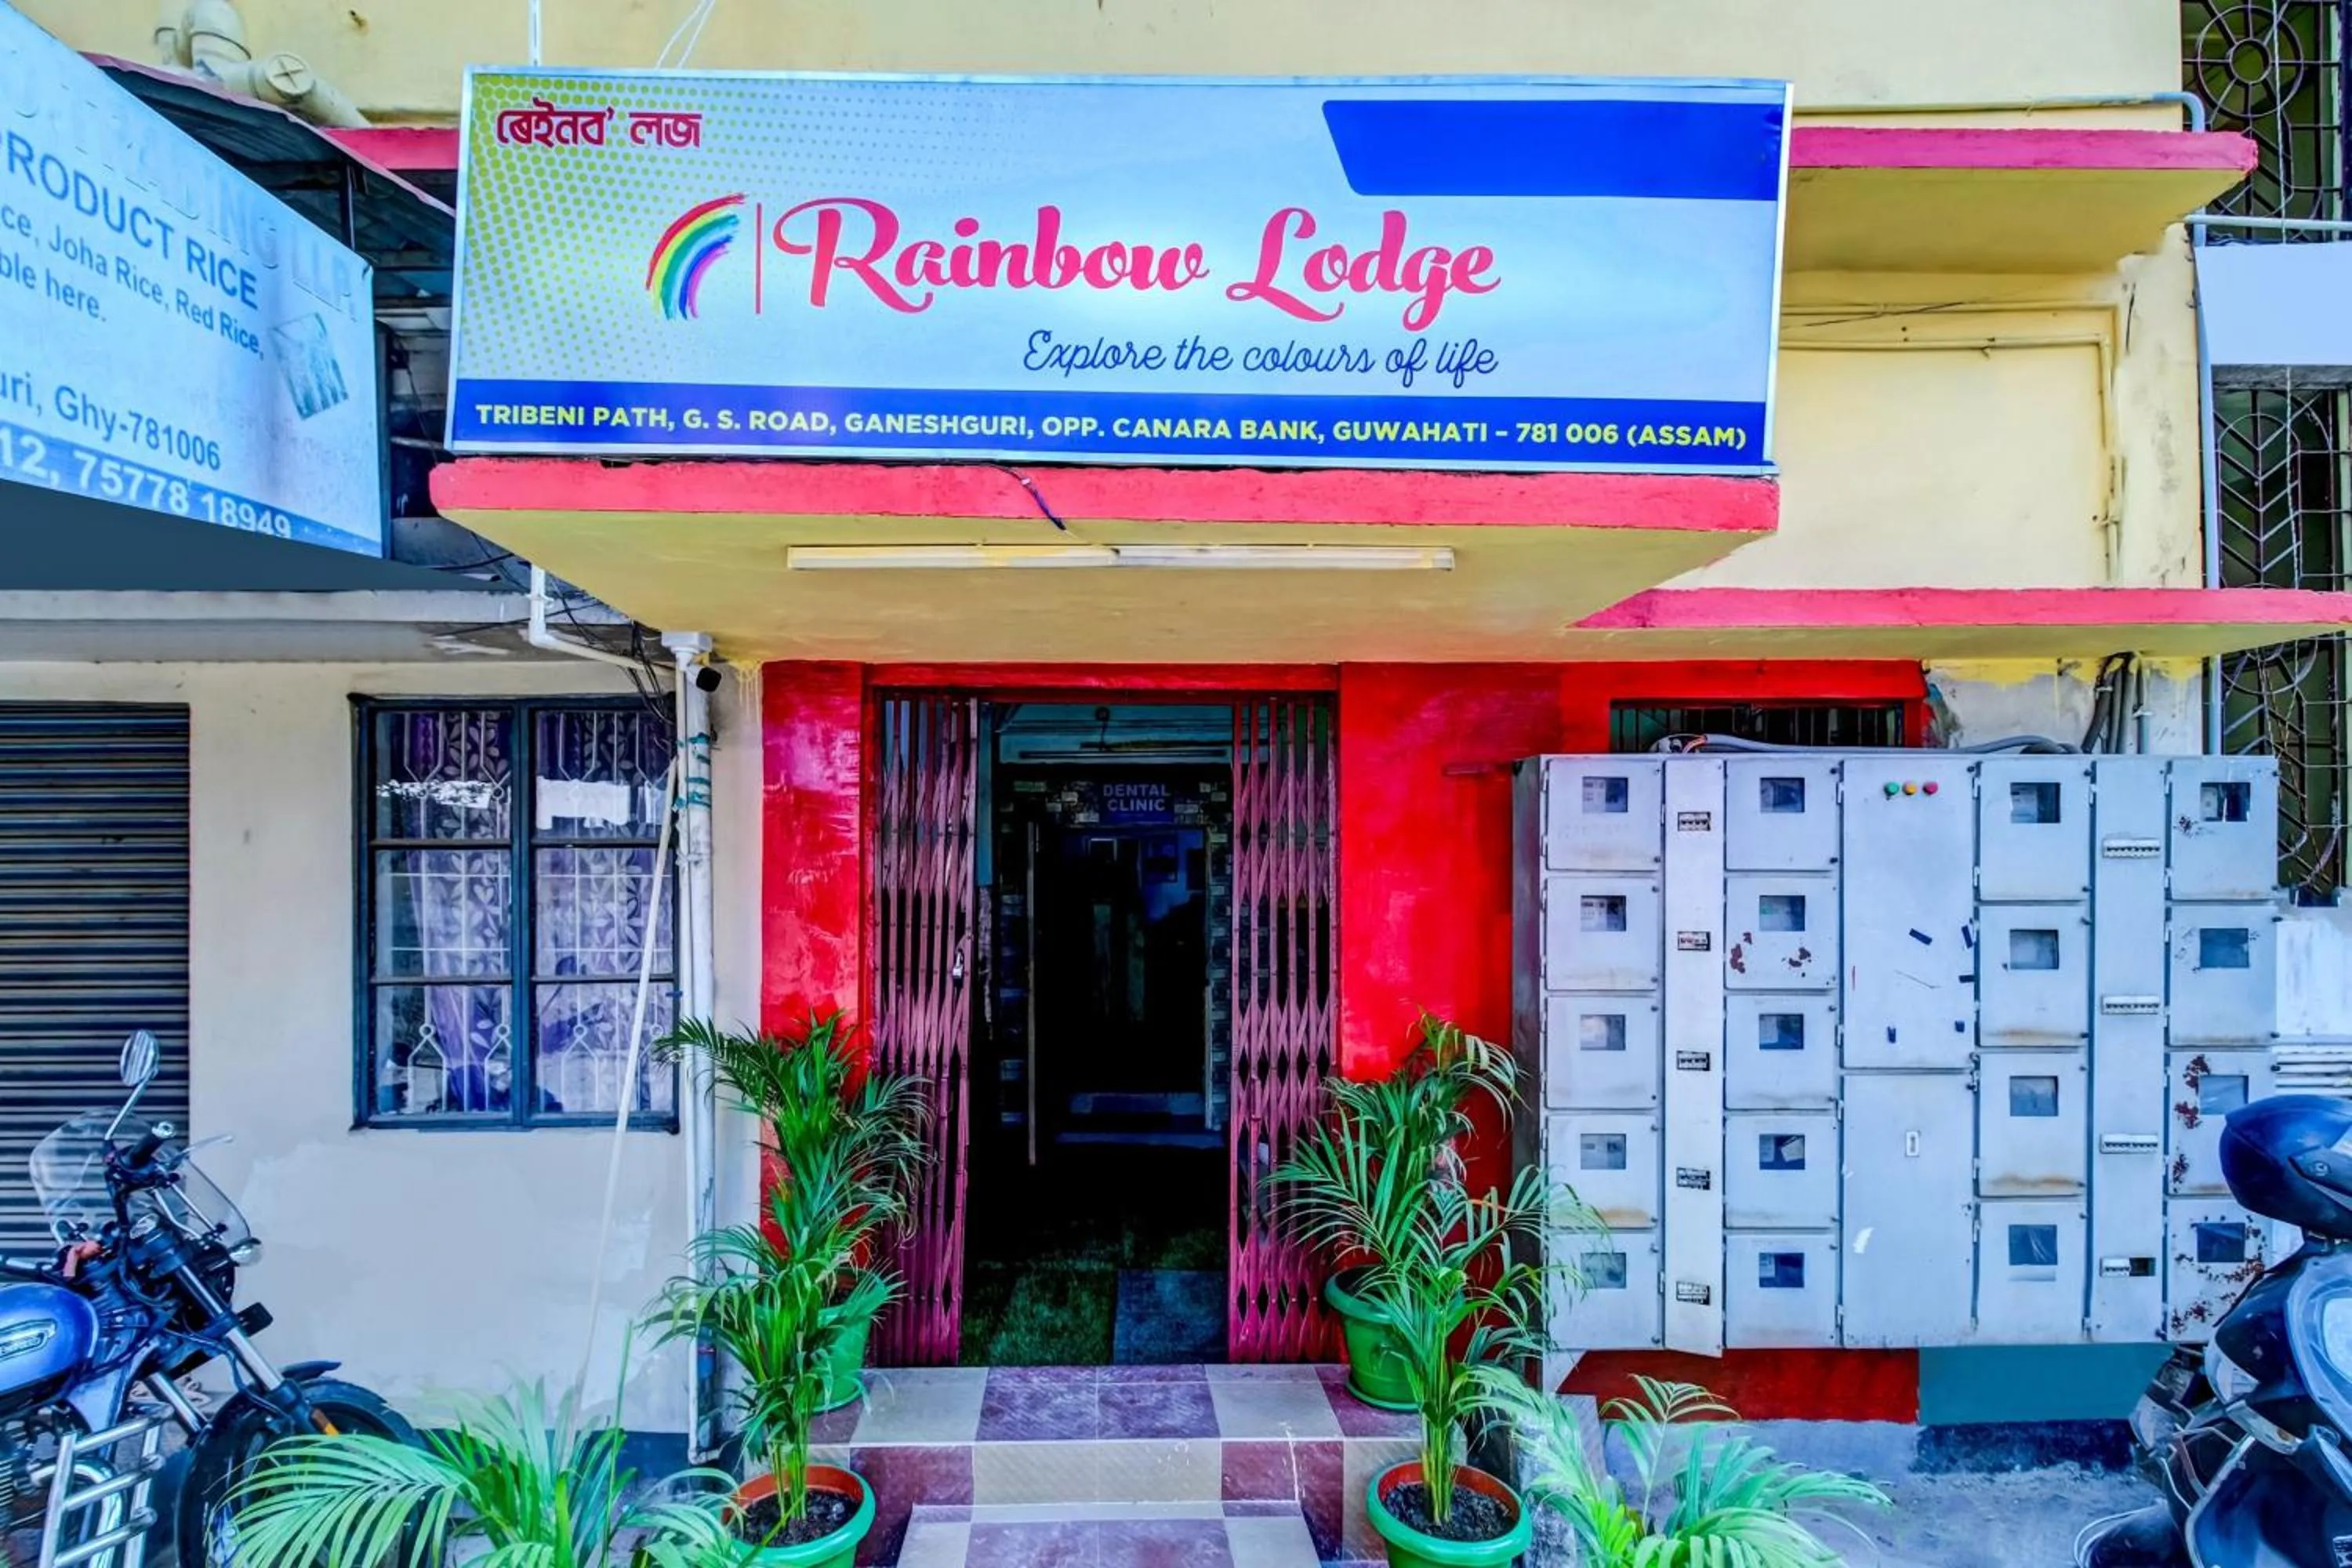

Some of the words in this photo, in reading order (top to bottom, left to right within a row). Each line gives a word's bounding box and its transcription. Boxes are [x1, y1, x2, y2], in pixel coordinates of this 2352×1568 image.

[628, 112, 702, 147] লজ
[0, 128, 174, 260] RODUCT
[186, 236, 259, 311] RICE
[48, 223, 108, 277] Joha
[115, 256, 169, 313] Rice,
[176, 288, 214, 331] Red
[220, 311, 264, 361] Rice,
[772, 197, 1210, 314] Rainbow
[1225, 207, 1502, 332] Lodge
[45, 267, 107, 322] here.
[1023, 329, 1165, 377] Explore
[1175, 335, 1233, 372] the
[1243, 339, 1376, 374] colours
[1385, 338, 1428, 388] of
[1436, 338, 1500, 388] life
[55, 385, 221, 470] Ghy-781006
[475, 404, 585, 426] TRIBENI
[593, 406, 675, 431] PATH,
[684, 409, 710, 429] G.
[717, 410, 741, 430] S.
[749, 410, 837, 436] ROAD,
[844, 412, 1035, 439] GANESHGURI,
[1042, 416, 1105, 437] OPP.
[1112, 418, 1232, 440] CANARA
[1240, 419, 1325, 445] BANK,
[1334, 421, 1487, 443] GUWAHATI
[1516, 423, 1558, 443] 781
[1566, 423, 1619, 444] 006
[1627, 425, 1747, 451] (ASSAM)
[72, 448, 190, 516] 75778
[201, 492, 292, 539] 18949
[1103, 784, 1171, 797] DENTAL
[1107, 799, 1165, 811] CLINIC
